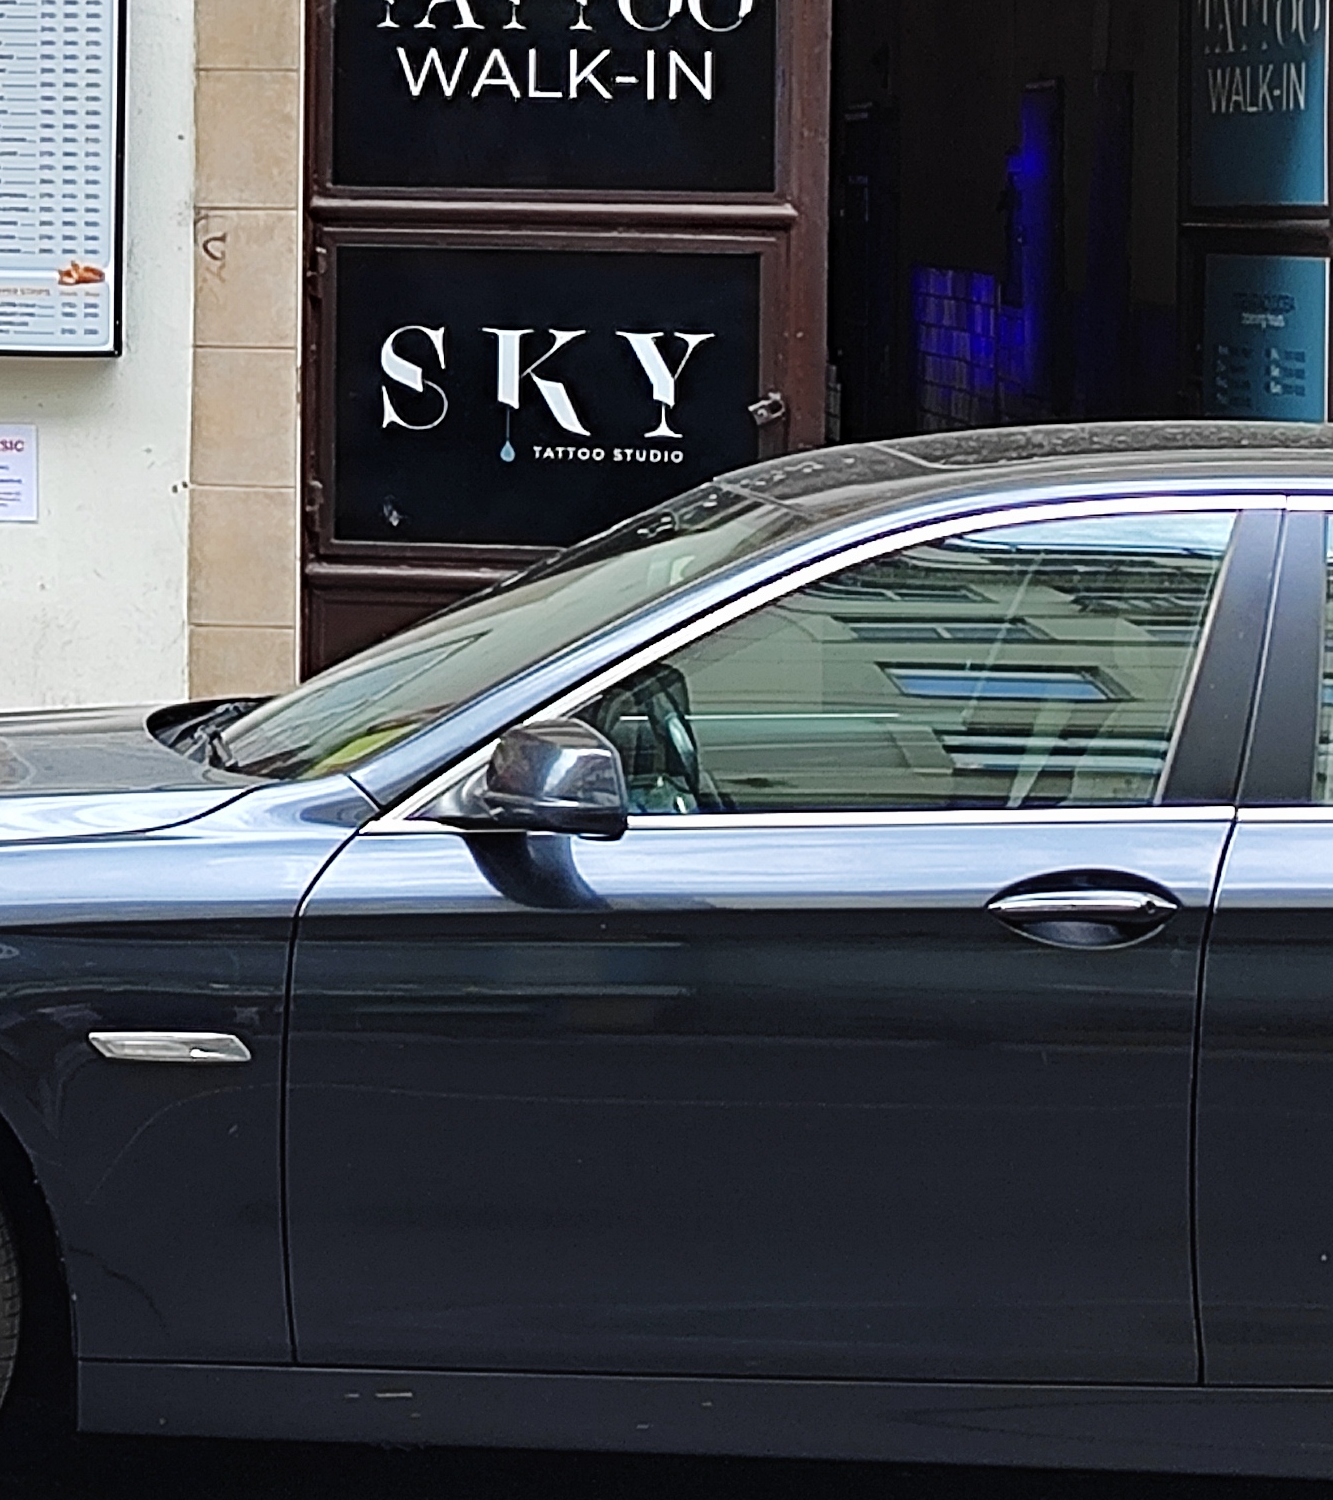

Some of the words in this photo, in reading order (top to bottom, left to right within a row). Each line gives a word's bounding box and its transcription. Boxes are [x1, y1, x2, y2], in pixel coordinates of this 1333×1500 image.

[395, 46, 713, 100] WALK-IN
[1207, 61, 1307, 113] WALK-IN
[380, 324, 717, 440] SKY
[533, 445, 606, 462] TATTOO
[613, 448, 685, 464] STUDIO
